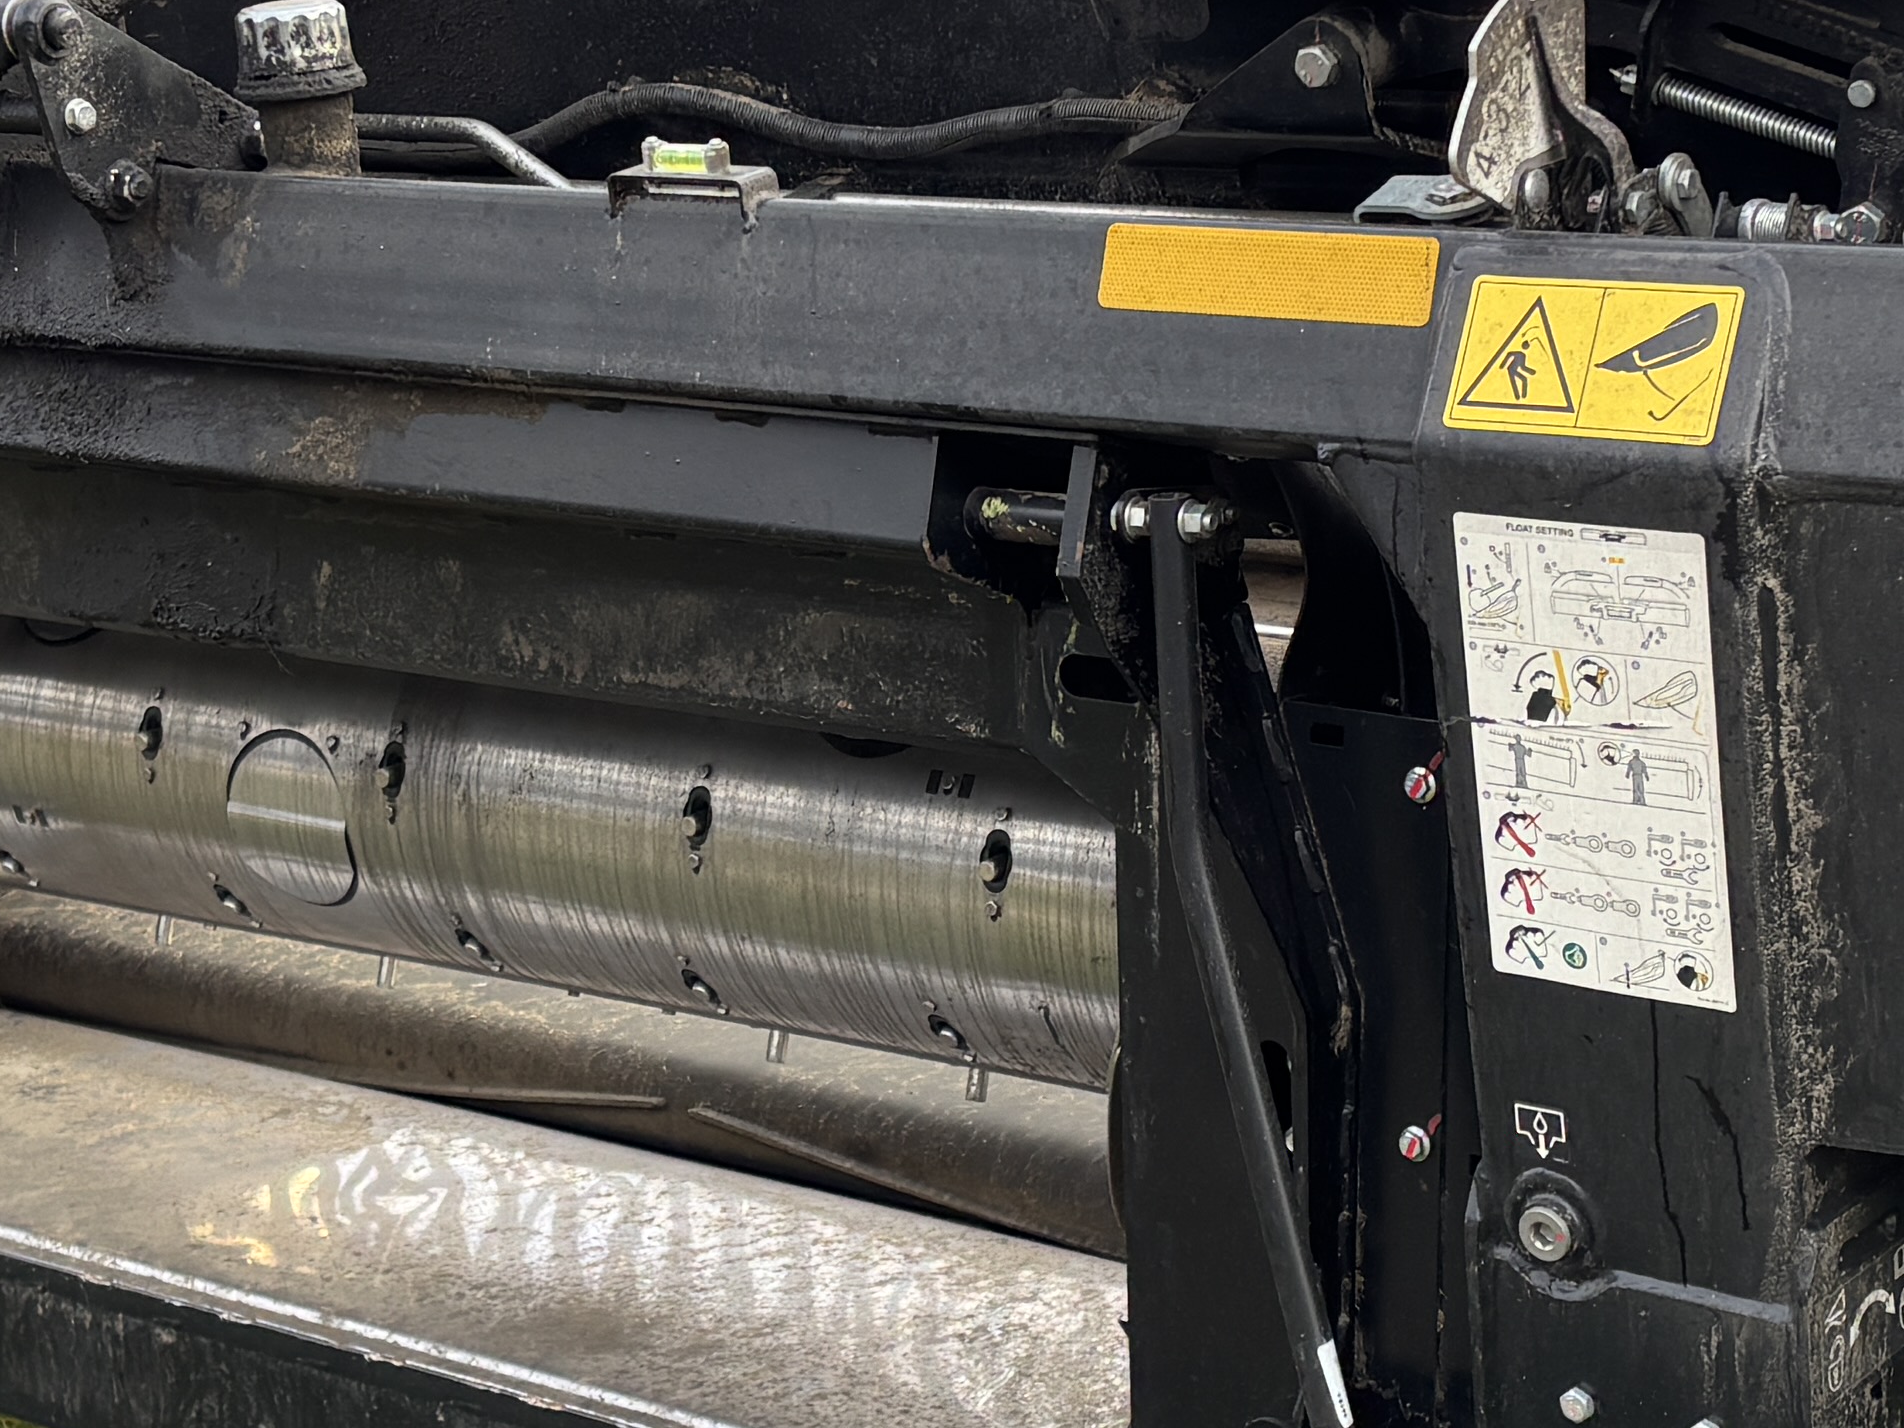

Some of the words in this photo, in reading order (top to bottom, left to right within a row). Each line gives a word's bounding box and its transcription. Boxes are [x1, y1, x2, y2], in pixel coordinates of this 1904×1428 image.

[1473, 150, 1498, 180] 4
[1505, 522, 1533, 533] FLOAT
[1535, 525, 1574, 538] SETTING
